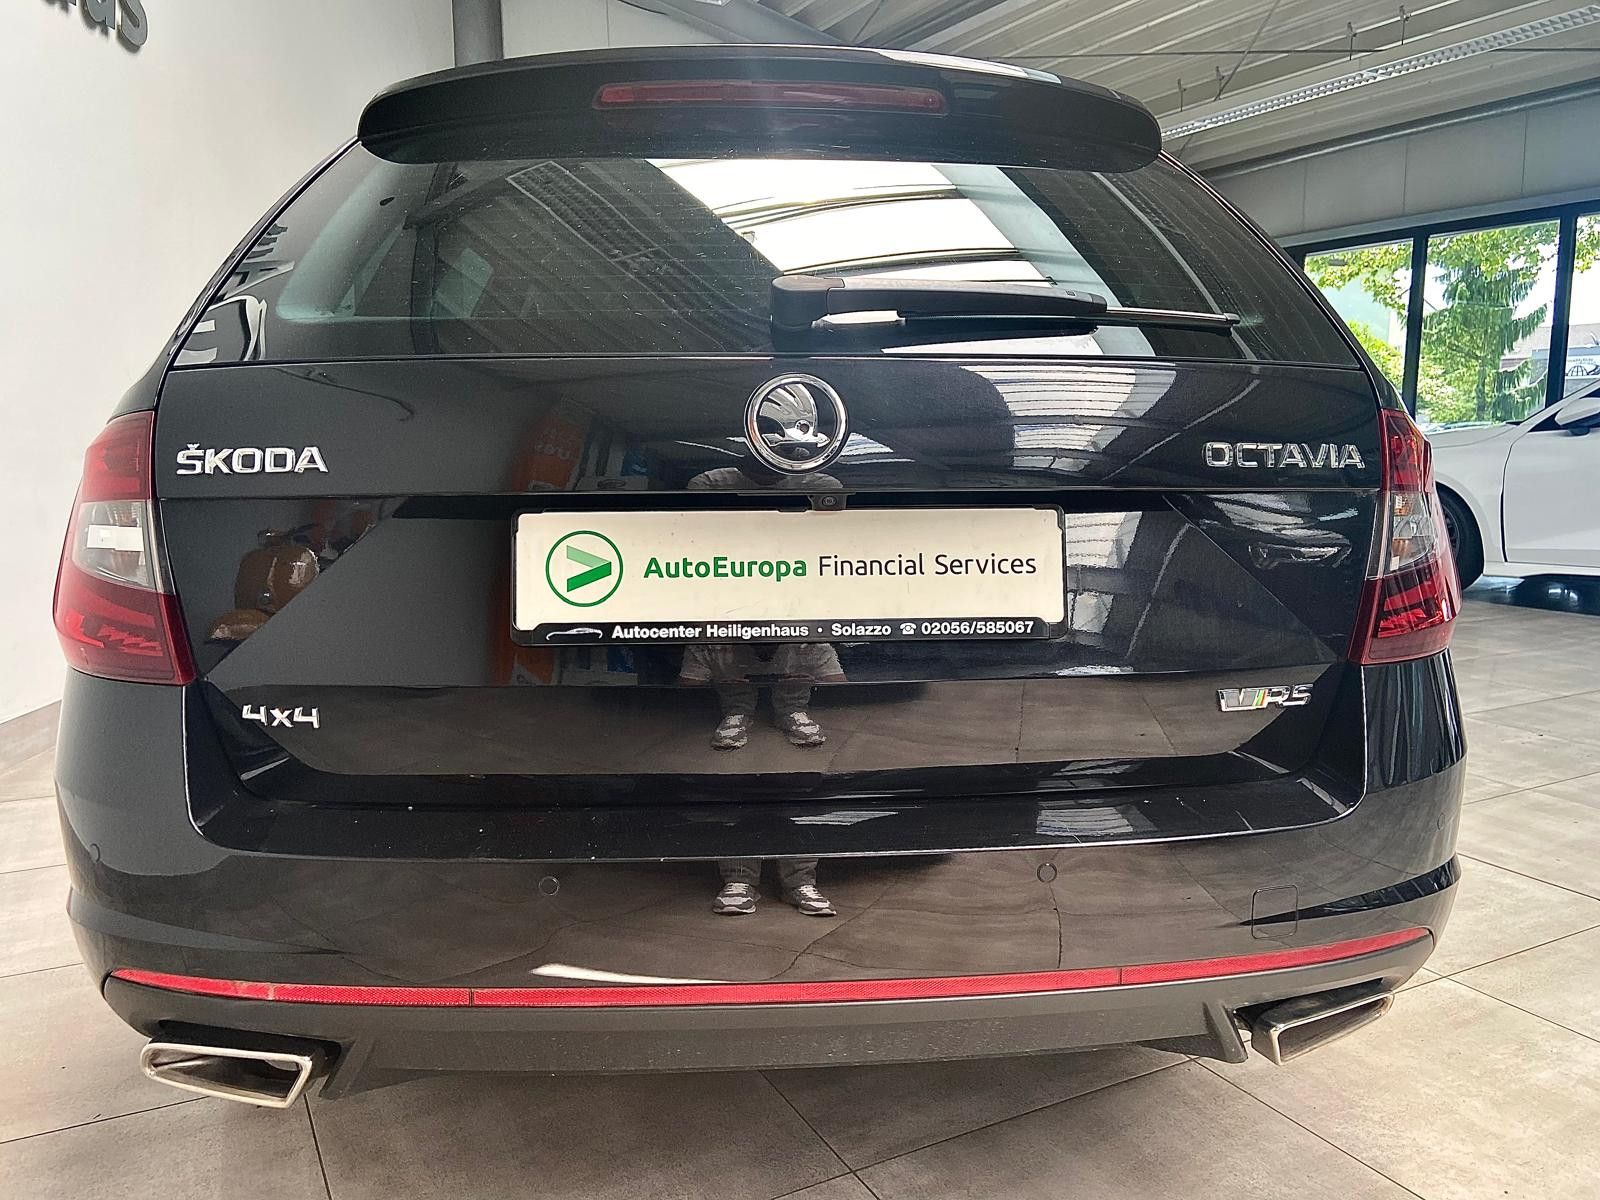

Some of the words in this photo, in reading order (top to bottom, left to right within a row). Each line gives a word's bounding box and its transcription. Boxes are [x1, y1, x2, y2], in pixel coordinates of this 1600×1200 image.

[176, 444, 328, 475] ŠKODA
[1203, 441, 1366, 470] OCTAVIA
[643, 553, 807, 582] AutoEuropa
[818, 552, 926, 578] Financial
[935, 552, 1037, 577] Services
[611, 622, 702, 640] Autocenter
[706, 621, 810, 642] Heiligenhaus
[831, 621, 892, 638] Solazzo
[921, 619, 1034, 637] 02056/585067
[241, 704, 320, 729] 4x4
